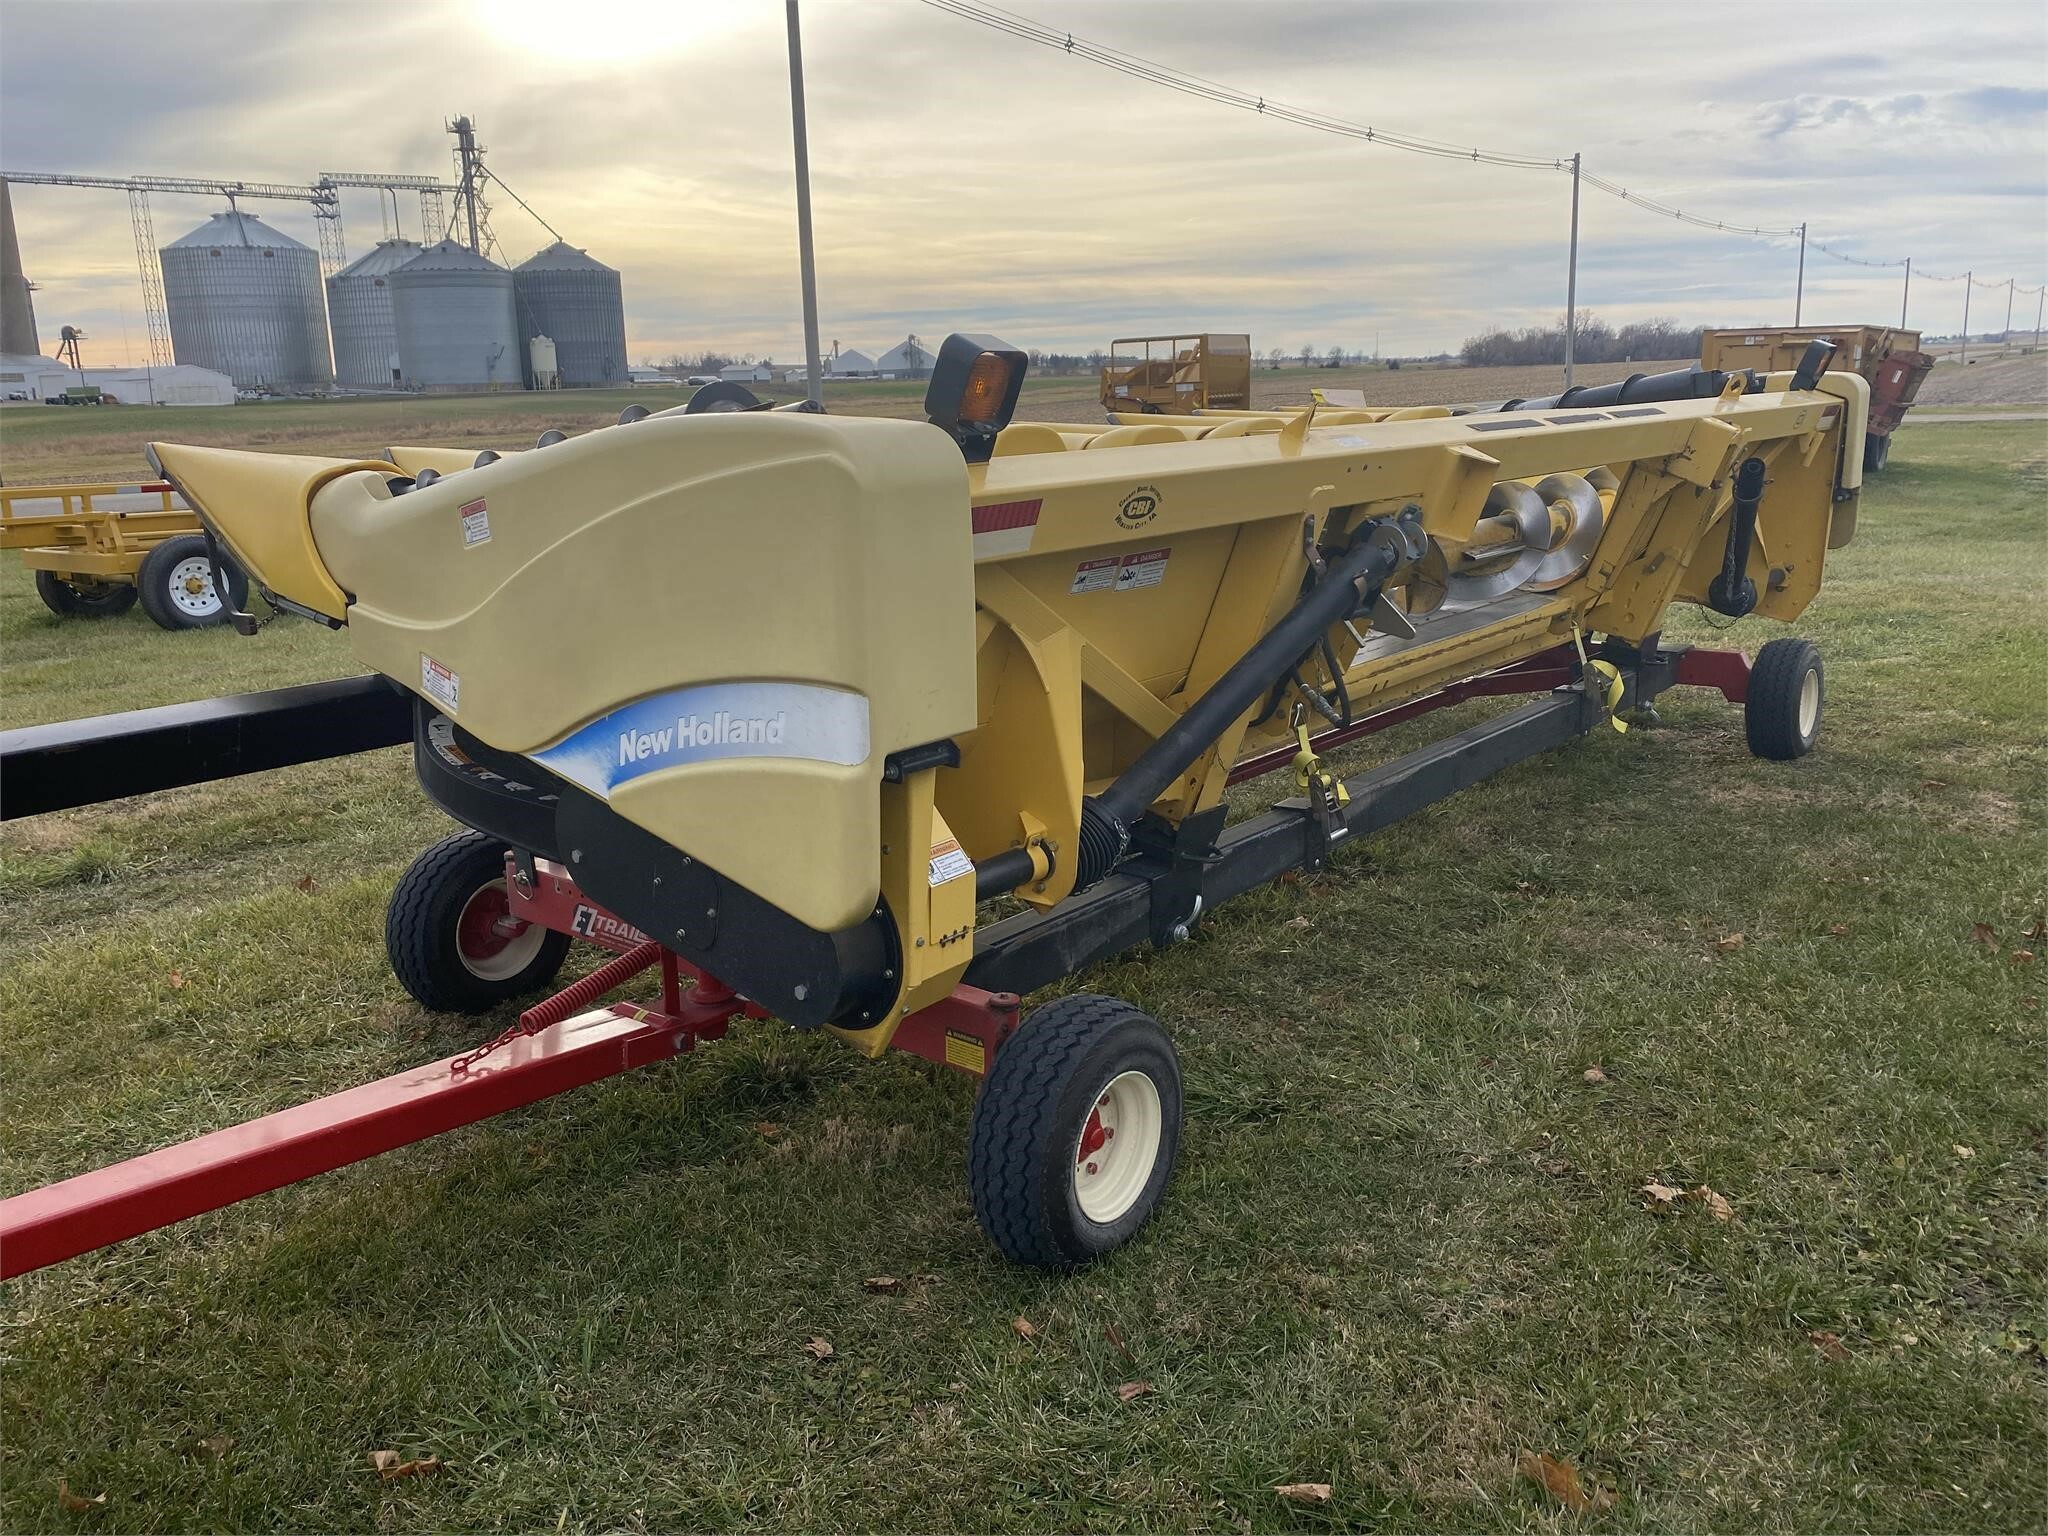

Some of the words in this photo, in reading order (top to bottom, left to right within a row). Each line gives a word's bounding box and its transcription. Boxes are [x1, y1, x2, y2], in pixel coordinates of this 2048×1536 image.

[1127, 500, 1152, 516] CBI
[619, 728, 673, 766] New
[677, 710, 785, 749] Holland
